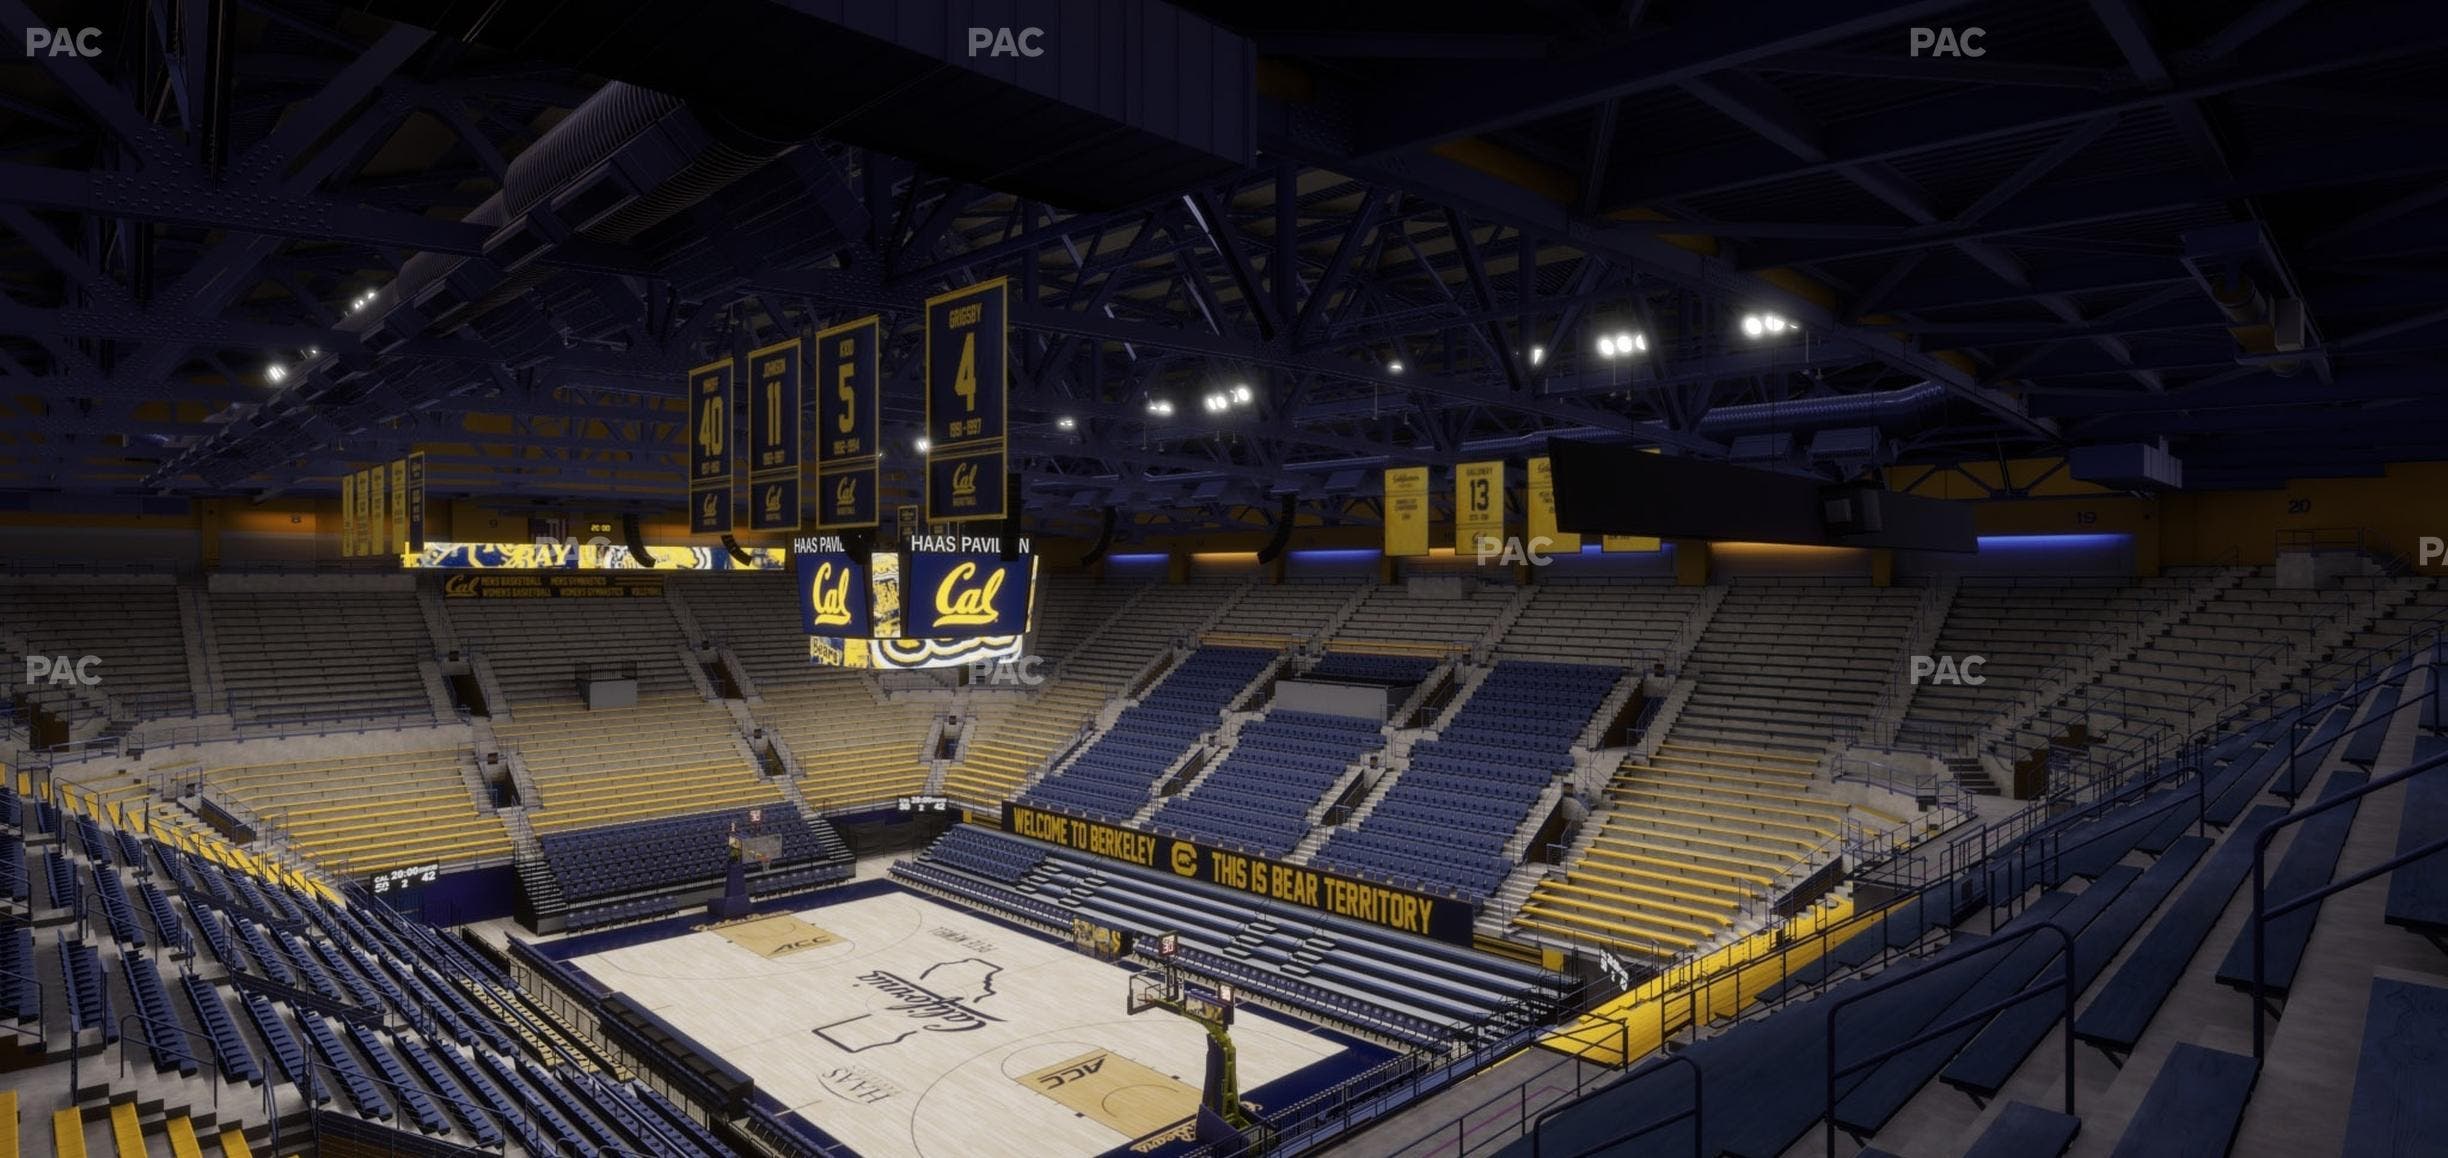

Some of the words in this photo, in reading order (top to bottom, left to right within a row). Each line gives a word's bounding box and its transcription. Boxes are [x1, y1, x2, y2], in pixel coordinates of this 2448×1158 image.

[949, 302, 982, 330] GRIGSBY
[954, 332, 976, 412] 4
[767, 380, 782, 446] 11
[838, 362, 855, 434] 5
[699, 395, 724, 457] 40
[836, 476, 857, 506] Cal
[952, 462, 979, 496] Cal
[1470, 479, 1489, 511] 13
[2287, 500, 2311, 514] 20
[794, 538, 818, 554] HAAS
[819, 536, 845, 553] PAVIL
[911, 535, 956, 553] HAAS
[962, 536, 1030, 554] PAVILN
[445, 574, 481, 598] Cal
[812, 561, 851, 626] Cal
[932, 561, 1006, 628] Cal
[813, 638, 839, 664] Bears
[374, 875, 390, 883] CAL
[391, 866, 419, 880] 20:00
[401, 879, 409, 888] 2
[421, 871, 436, 881] 42
[1013, 807, 1068, 845] WELCOME
[1071, 821, 1088, 850] TO
[1090, 825, 1157, 867] BERKELEY
[1211, 851, 1247, 890] THIS
[1250, 860, 1269, 895] IS
[1271, 865, 1319, 907] BEAR
[1323, 877, 1434, 935] TERRITORY
[773, 935, 831, 953] ACC
[855, 970, 988, 1032] California
[822, 1066, 890, 1104] HAAS
[1039, 1058, 1106, 1090] ACC
